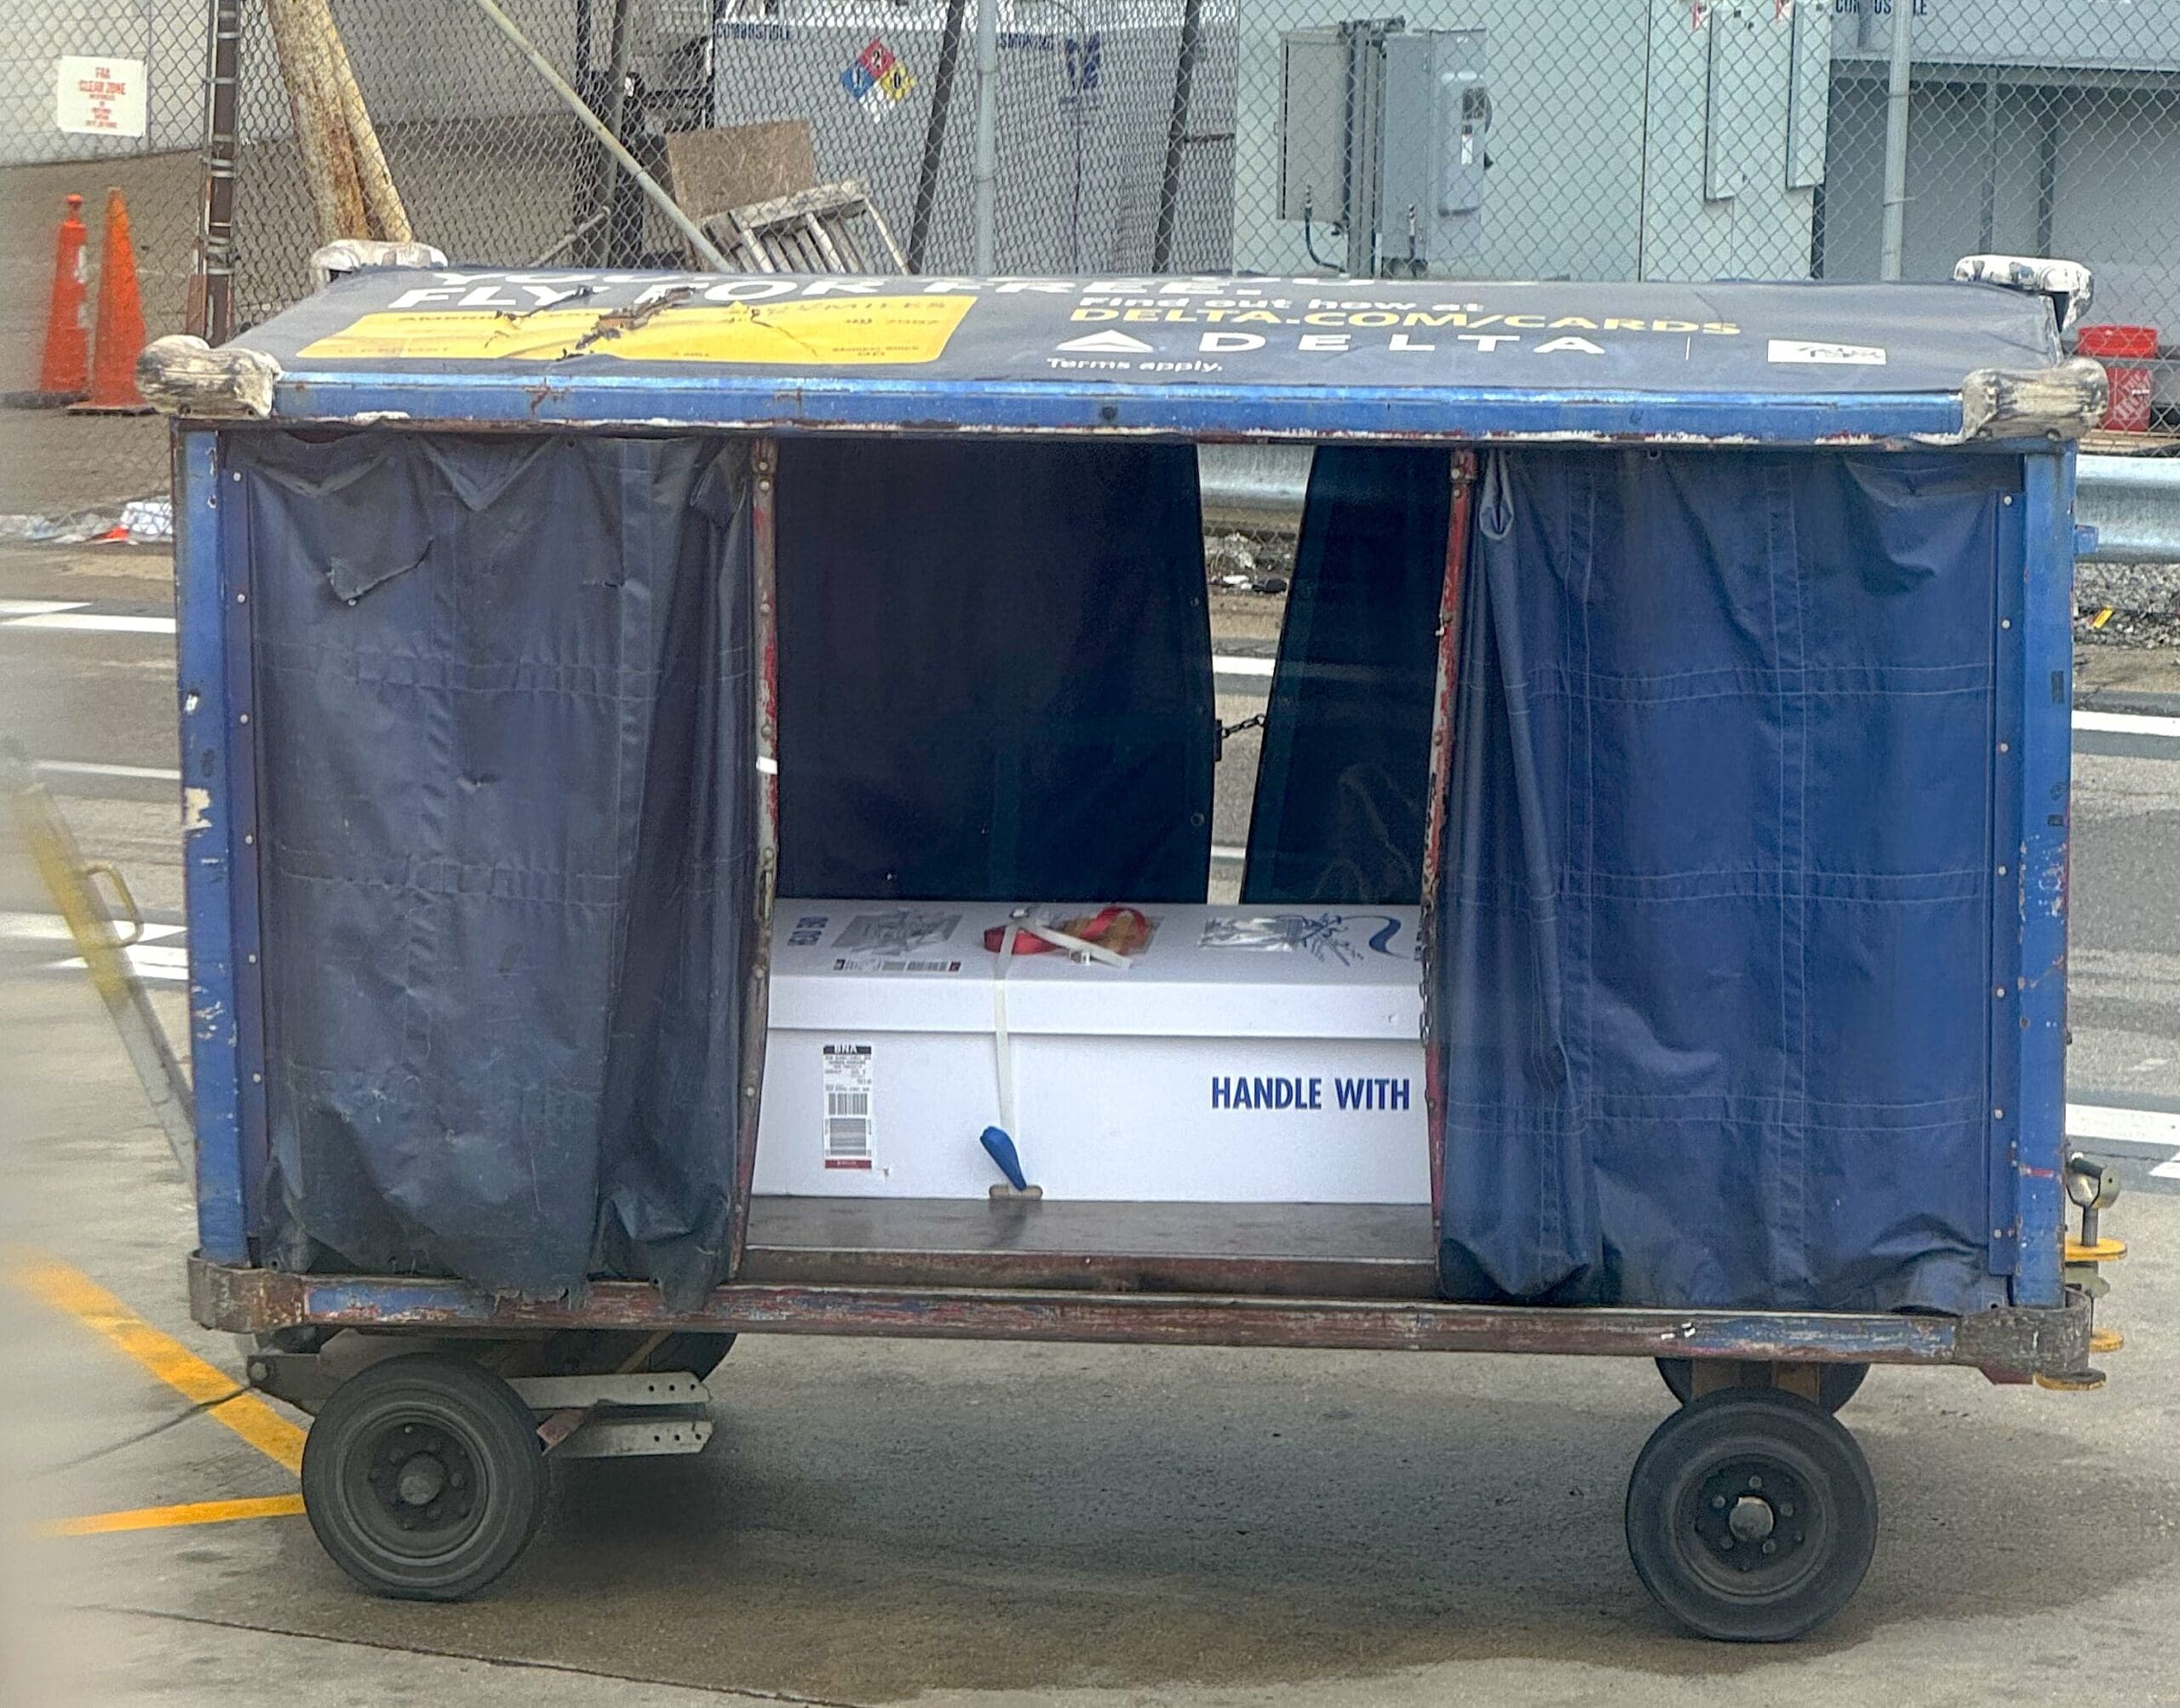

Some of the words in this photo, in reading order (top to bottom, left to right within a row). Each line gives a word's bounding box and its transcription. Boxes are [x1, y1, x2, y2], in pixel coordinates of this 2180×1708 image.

[79, 80, 103, 92] CLEAR
[106, 82, 125, 95] ZONE
[388, 285, 611, 308] FLY
[634, 279, 886, 305] FOR
[1080, 297, 1190, 307] Find
[1205, 299, 1293, 309] out
[1308, 299, 1416, 310] how
[1432, 302, 1483, 312] at
[1070, 309, 1741, 334] DELTA.COM/CARDS
[1199, 332, 1606, 354] DELTA
[1046, 358, 1131, 370] Terms
[1139, 359, 1223, 372] apply.
[1212, 1076, 1322, 1110] HANDLE
[1334, 1077, 1410, 1110] WITH
